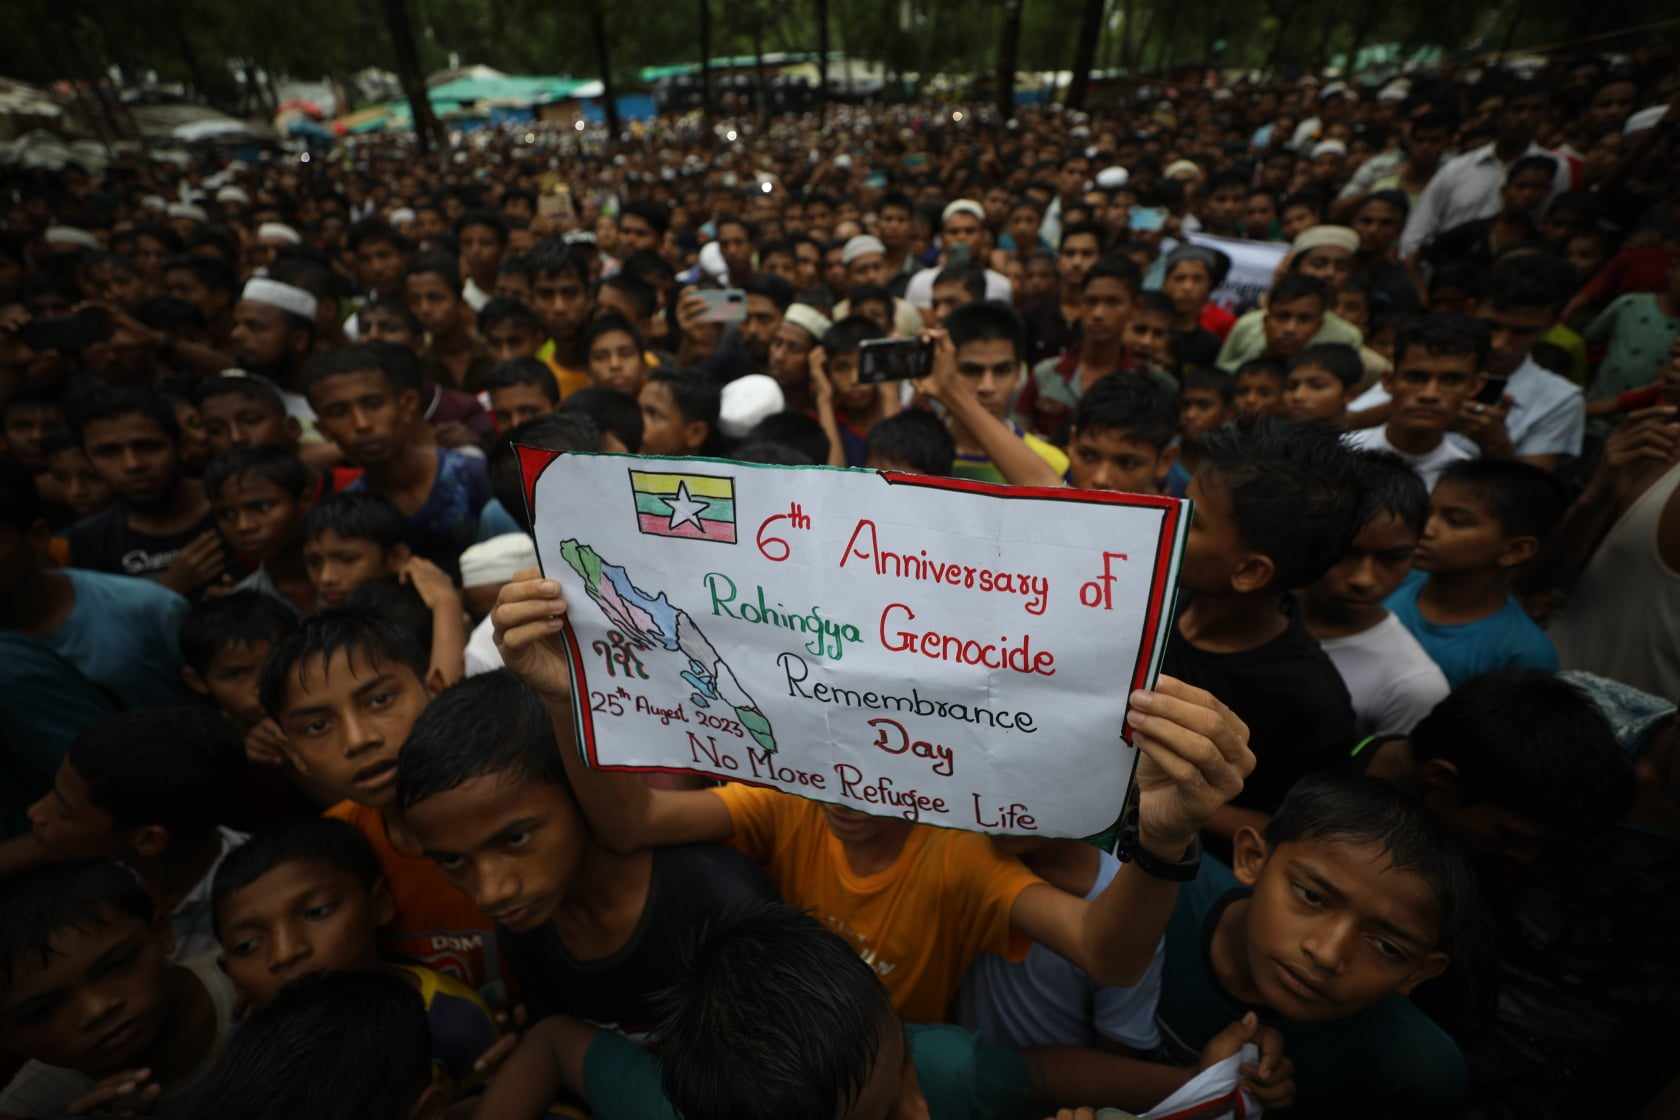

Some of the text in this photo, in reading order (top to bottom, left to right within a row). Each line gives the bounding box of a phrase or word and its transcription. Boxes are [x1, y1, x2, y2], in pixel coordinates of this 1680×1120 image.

[757, 502, 811, 562] 6th
[839, 519, 1048, 615] Anniversary
[703, 572, 864, 660] Rohingya
[880, 603, 1056, 676] Genocide
[591, 686, 631, 716] 25th
[695, 711, 744, 738] 2023
[776, 652, 1038, 733] Remembrance
[686, 731, 1038, 830] No More Refugee Life
[866, 718, 953, 776] Day
